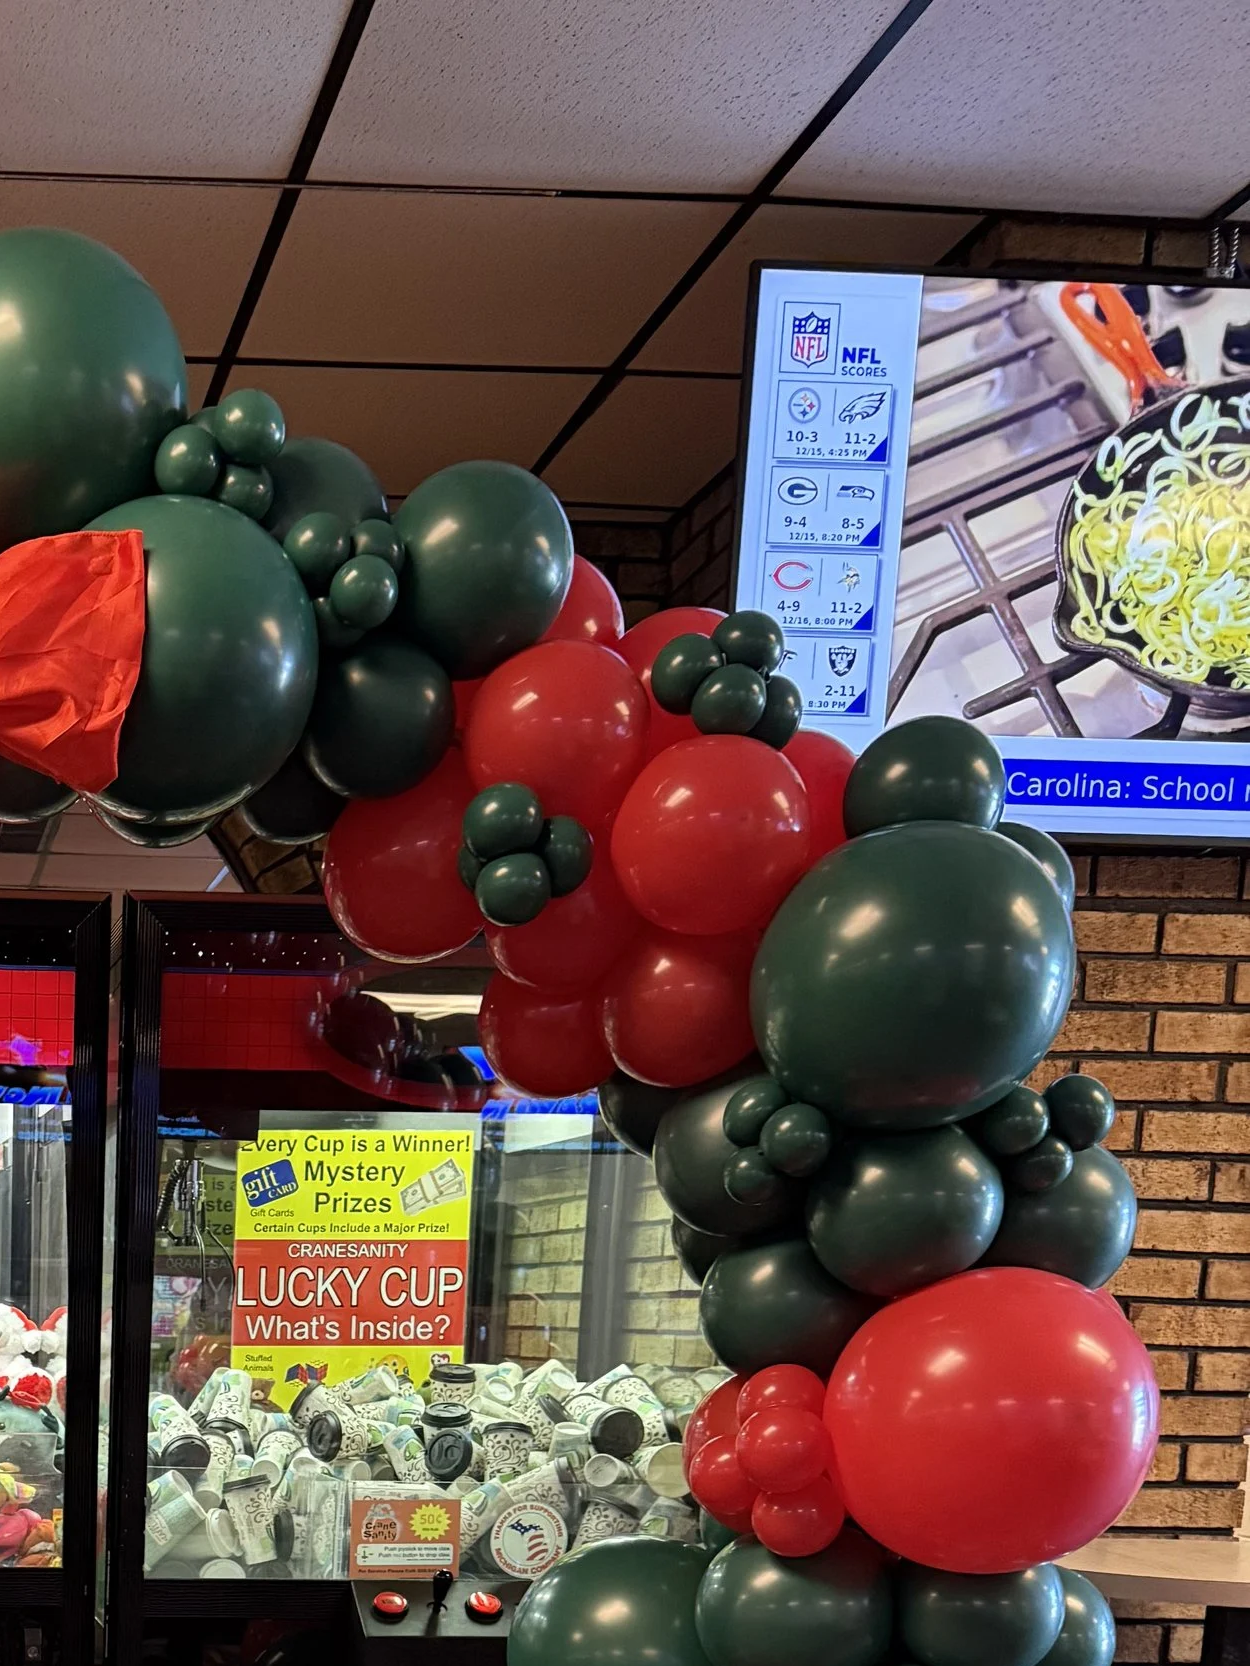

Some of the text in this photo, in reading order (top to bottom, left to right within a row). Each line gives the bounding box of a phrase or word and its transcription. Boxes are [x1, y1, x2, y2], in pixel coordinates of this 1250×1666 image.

[794, 336, 825, 361] NFL
[842, 347, 881, 364] NFL
[841, 366, 887, 377] SCORES
[786, 430, 818, 443] 10-3
[845, 433, 876, 445] 11-2
[796, 447, 867, 457] 12/15, 4:25 PM
[784, 516, 807, 528] 9-4
[842, 518, 864, 529] 8-5
[789, 532, 860, 542] 12/15, 8:20 PM
[777, 600, 800, 612] 4-9
[831, 602, 862, 614] 11-2
[782, 616, 853, 626] 12/16, 8:00 PM
[825, 685, 856, 697] 2-11
[808, 700, 846, 709] 8:30 PM
[1007, 772, 1130, 799] Carolina:
[1142, 776, 1234, 802] School
[304, 1135, 345, 1155] Cup
[352, 1135, 367, 1152] is
[375, 1139, 386, 1152] a
[393, 1135, 470, 1153] Winner!
[304, 1160, 405, 1186] Mystery
[244, 1165, 280, 1200] gift
[267, 1181, 297, 1199] CARD
[314, 1192, 392, 1213] Prizes
[250, 1208, 294, 1217] Gift Cards
[254, 1223, 449, 1235] Certain Cups Include a Major Prize!
[288, 1243, 408, 1258] CRANESANITY
[236, 1266, 371, 1307] LUCKY
[379, 1266, 464, 1307] CUP
[245, 1315, 340, 1341] What's
[351, 1315, 451, 1341] Inside?
[245, 1355, 272, 1363] Stuffed
[243, 1364, 274, 1372] Animals
[420, 1513, 443, 1525] 50¢
[494, 1505, 563, 1540] THANKS FOR SUPPORTING
[365, 1521, 397, 1530] Crane
[363, 1530, 397, 1541] Sanity
[495, 1545, 562, 1574] MICHIGAN COMPANY
